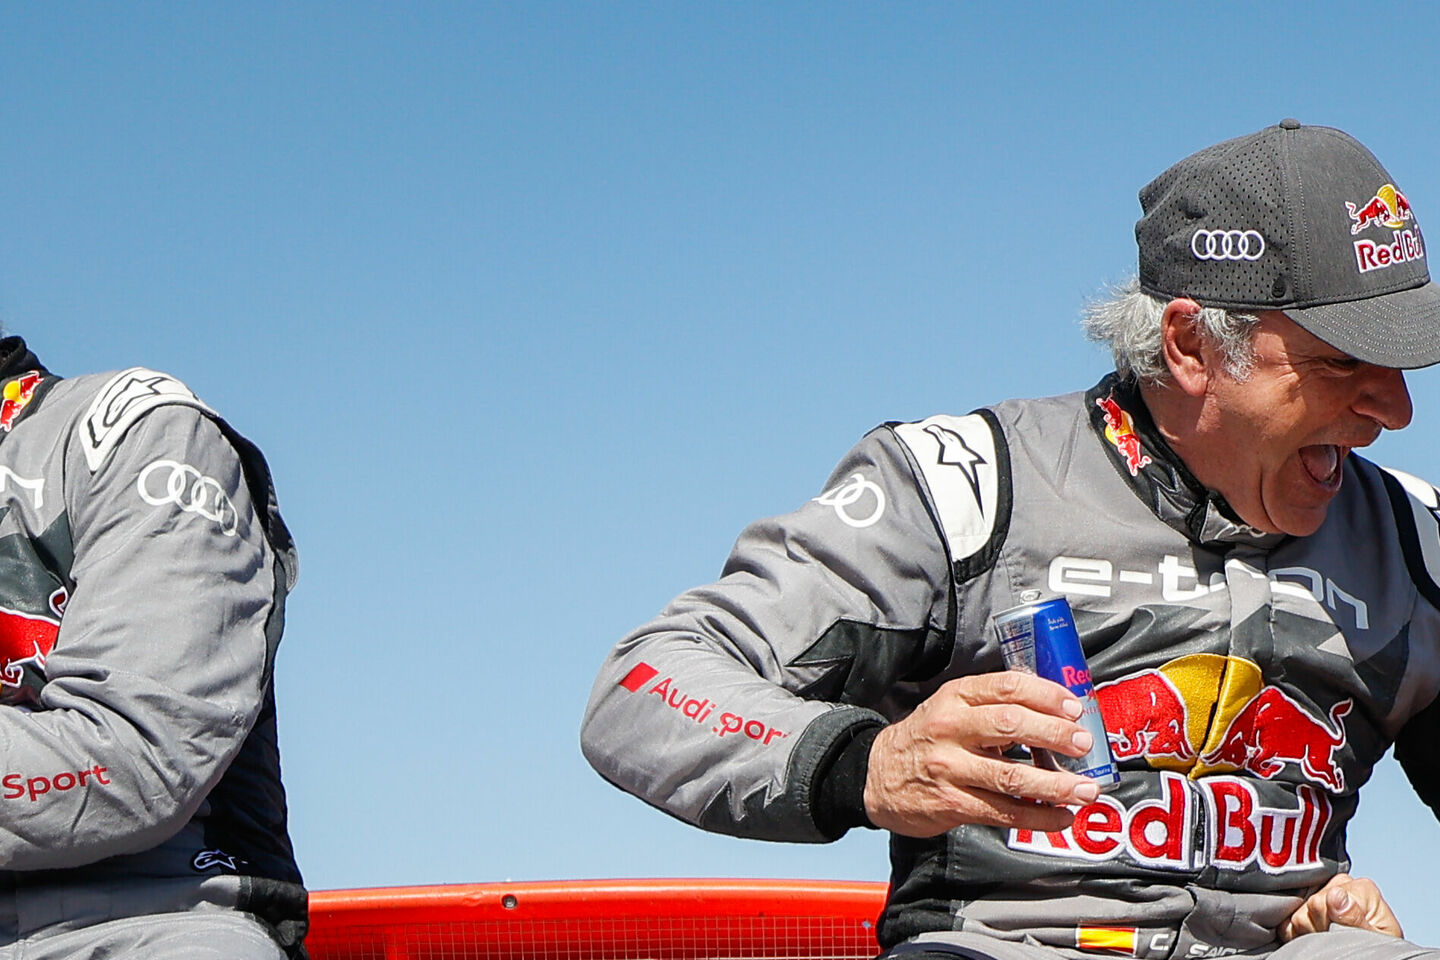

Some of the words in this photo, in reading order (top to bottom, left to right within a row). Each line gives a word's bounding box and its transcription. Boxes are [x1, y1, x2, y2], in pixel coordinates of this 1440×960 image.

[1356, 231, 1404, 271] Red
[650, 677, 717, 724] Audi
[2, 765, 111, 802] Sport
[1207, 777, 1332, 870] Bull
